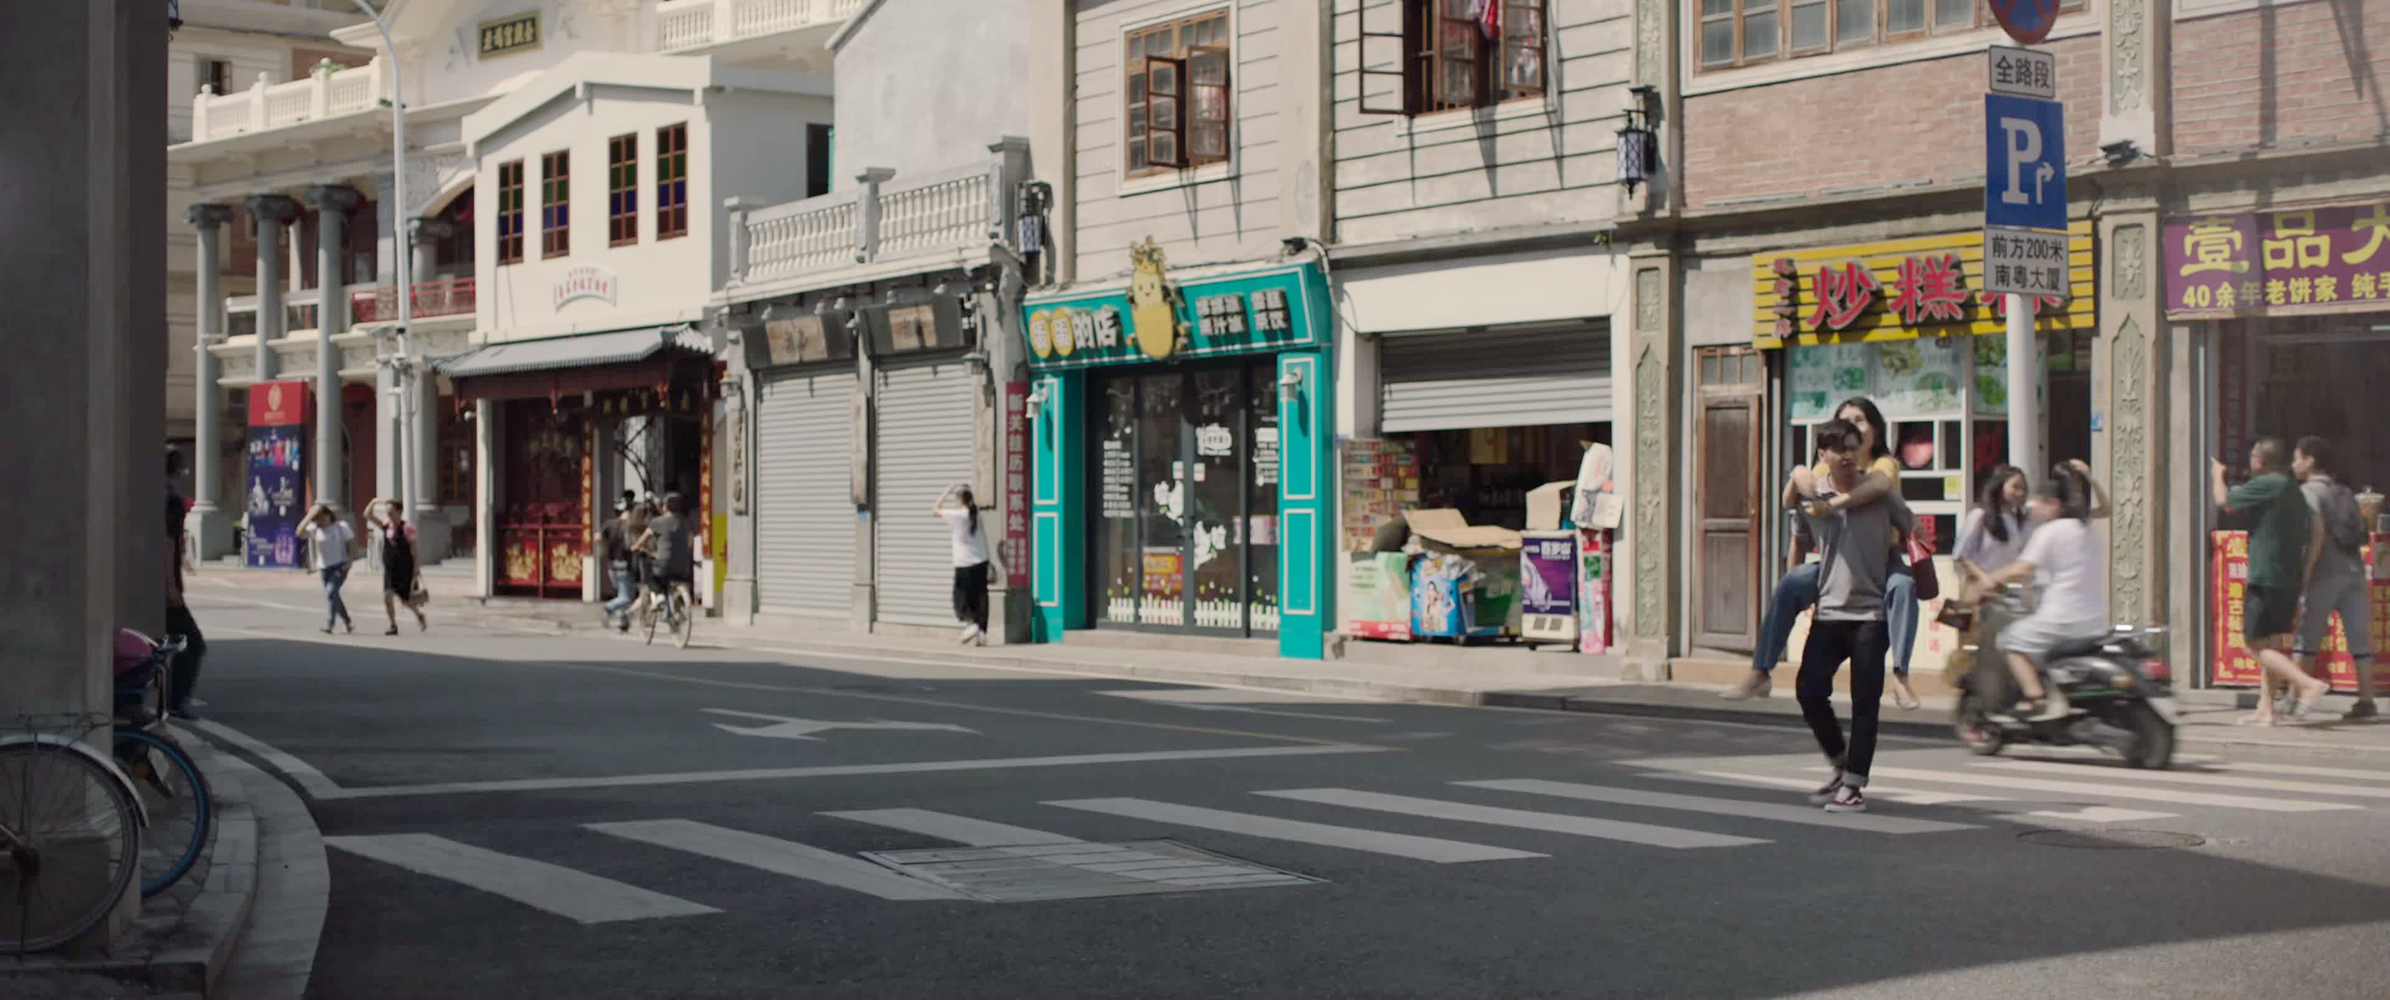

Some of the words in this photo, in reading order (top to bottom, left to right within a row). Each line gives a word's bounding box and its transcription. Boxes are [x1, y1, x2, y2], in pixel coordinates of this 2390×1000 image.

[1995, 56, 2051, 89] 全路段
[2000, 117, 2042, 205] P
[1992, 234, 2064, 262] 前方200米
[1806, 254, 2061, 328] 炒糕
[1995, 264, 2062, 291] 南粤大厦
[2182, 275, 2338, 308] 40余年老饼家
